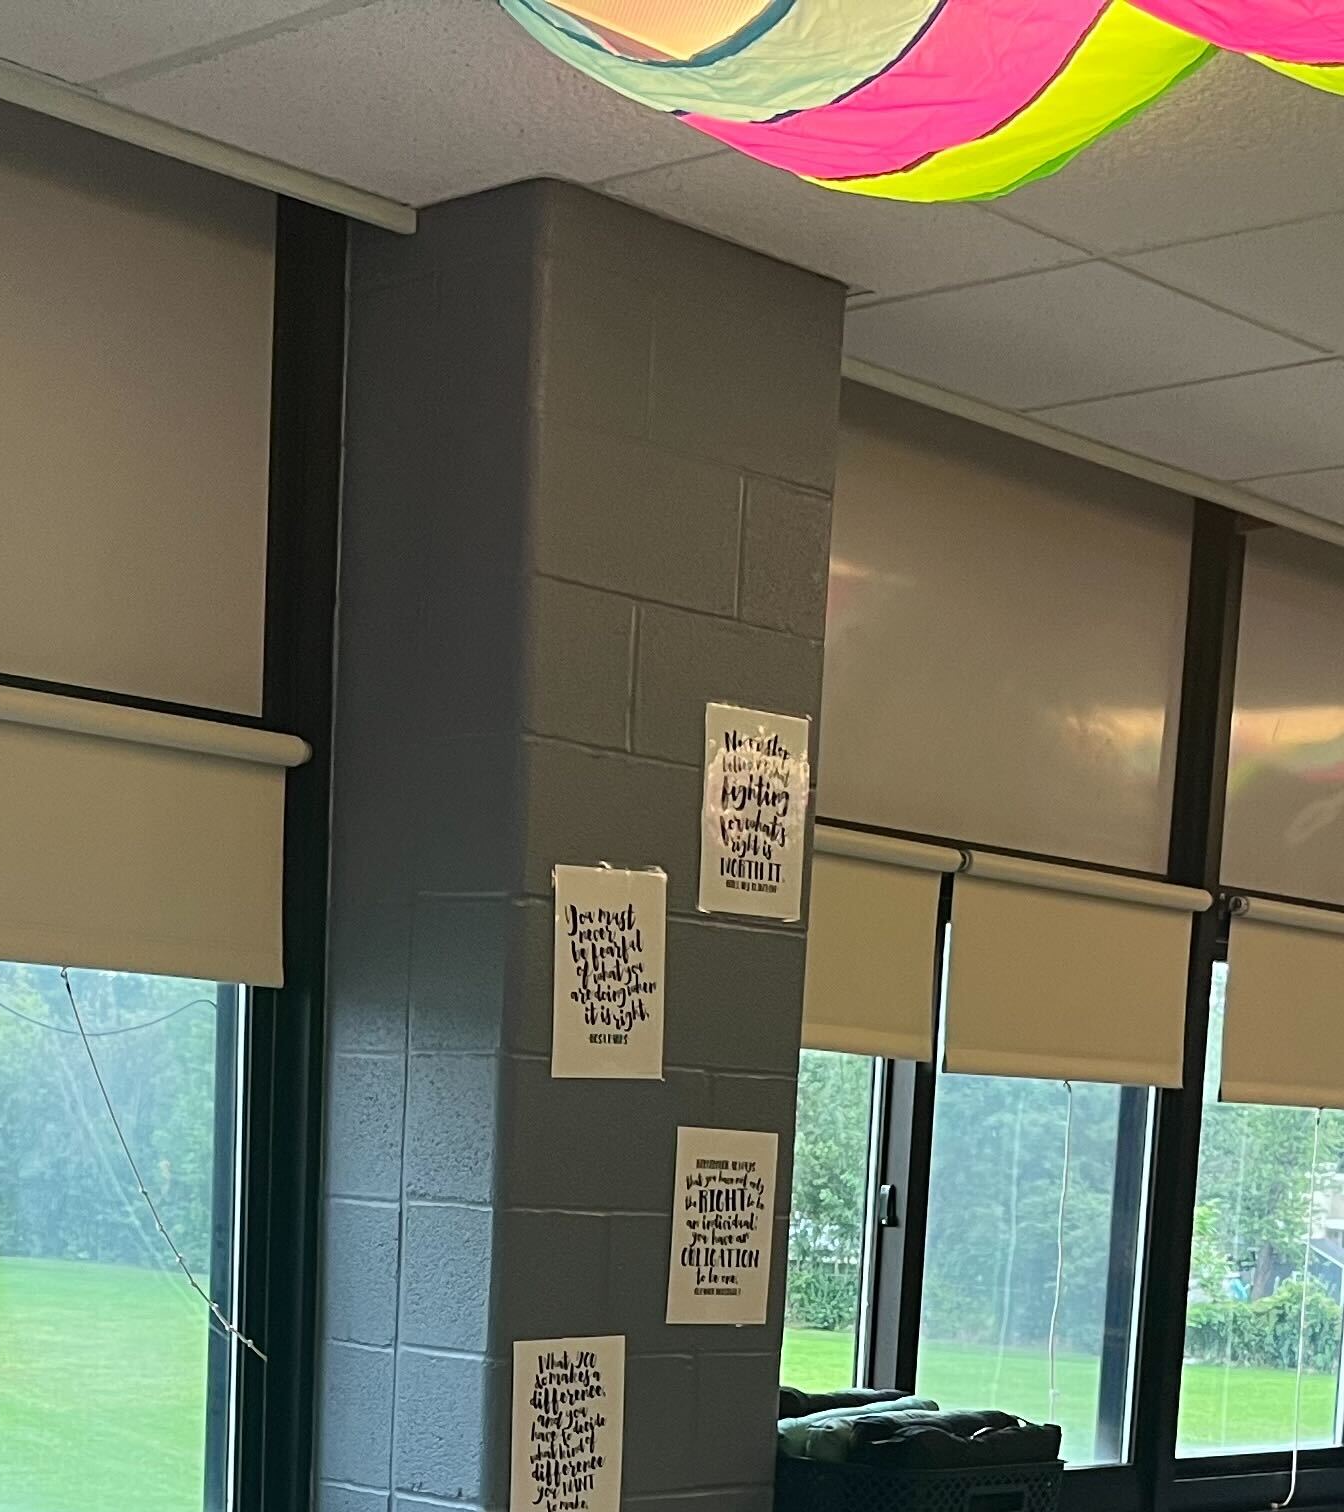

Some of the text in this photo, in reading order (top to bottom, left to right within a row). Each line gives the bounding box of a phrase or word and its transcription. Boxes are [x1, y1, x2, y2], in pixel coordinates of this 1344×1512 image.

[721, 774, 790, 817] fighting
[763, 840, 772, 860] is
[720, 857, 763, 880] WORTH
[564, 903, 636, 936] You must
[571, 929, 643, 971] be fearful
[576, 959, 644, 990] of what you
[570, 972, 656, 1008] are doing when
[584, 1002, 598, 1026] it
[600, 1005, 613, 1026] is
[698, 1188, 748, 1213] RIGHT
[681, 1247, 760, 1268] OBLIGATION
[538, 1350, 569, 1374] What
[534, 1362, 601, 1389] do makes a
[537, 1406, 588, 1430] and you
[529, 1440, 558, 1465] what
[559, 1437, 585, 1460] kind
[531, 1456, 607, 1488] difference
[532, 1485, 560, 1505] you
